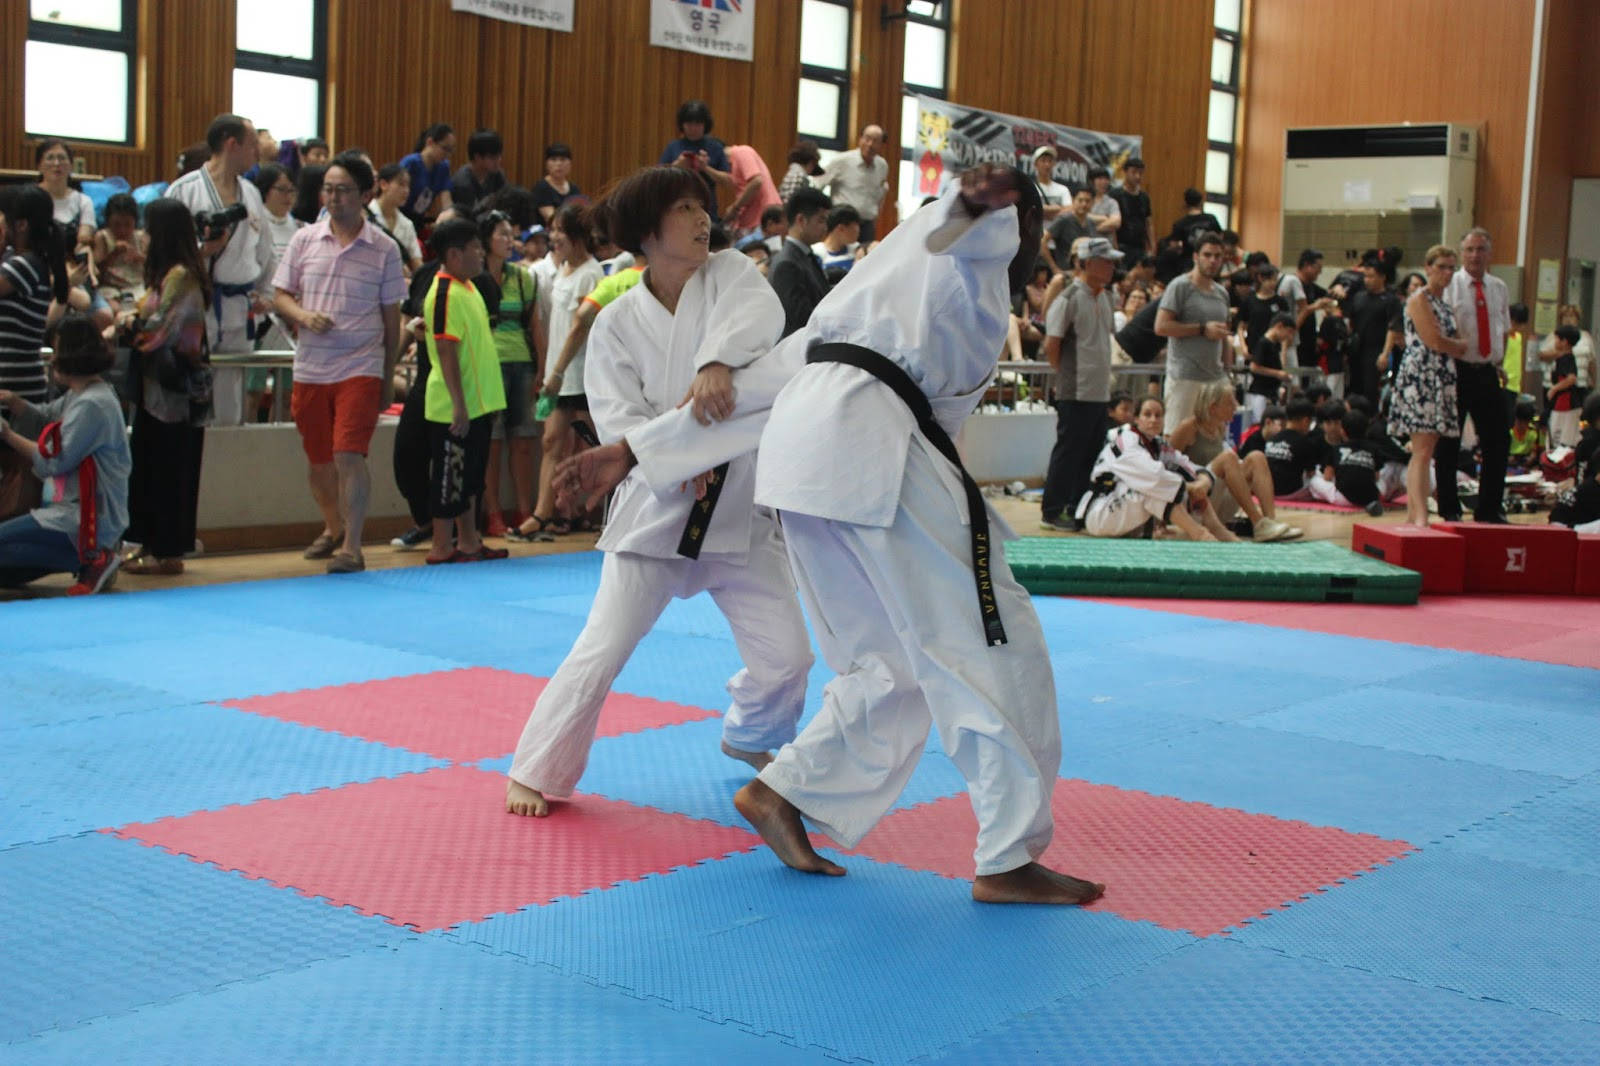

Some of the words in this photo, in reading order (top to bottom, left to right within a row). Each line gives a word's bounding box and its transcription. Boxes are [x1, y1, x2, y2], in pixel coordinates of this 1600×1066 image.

[690, 9, 721, 35] 영국
[952, 140, 1017, 168] HAPKIDO
[975, 533, 996, 614] JAWANZA
